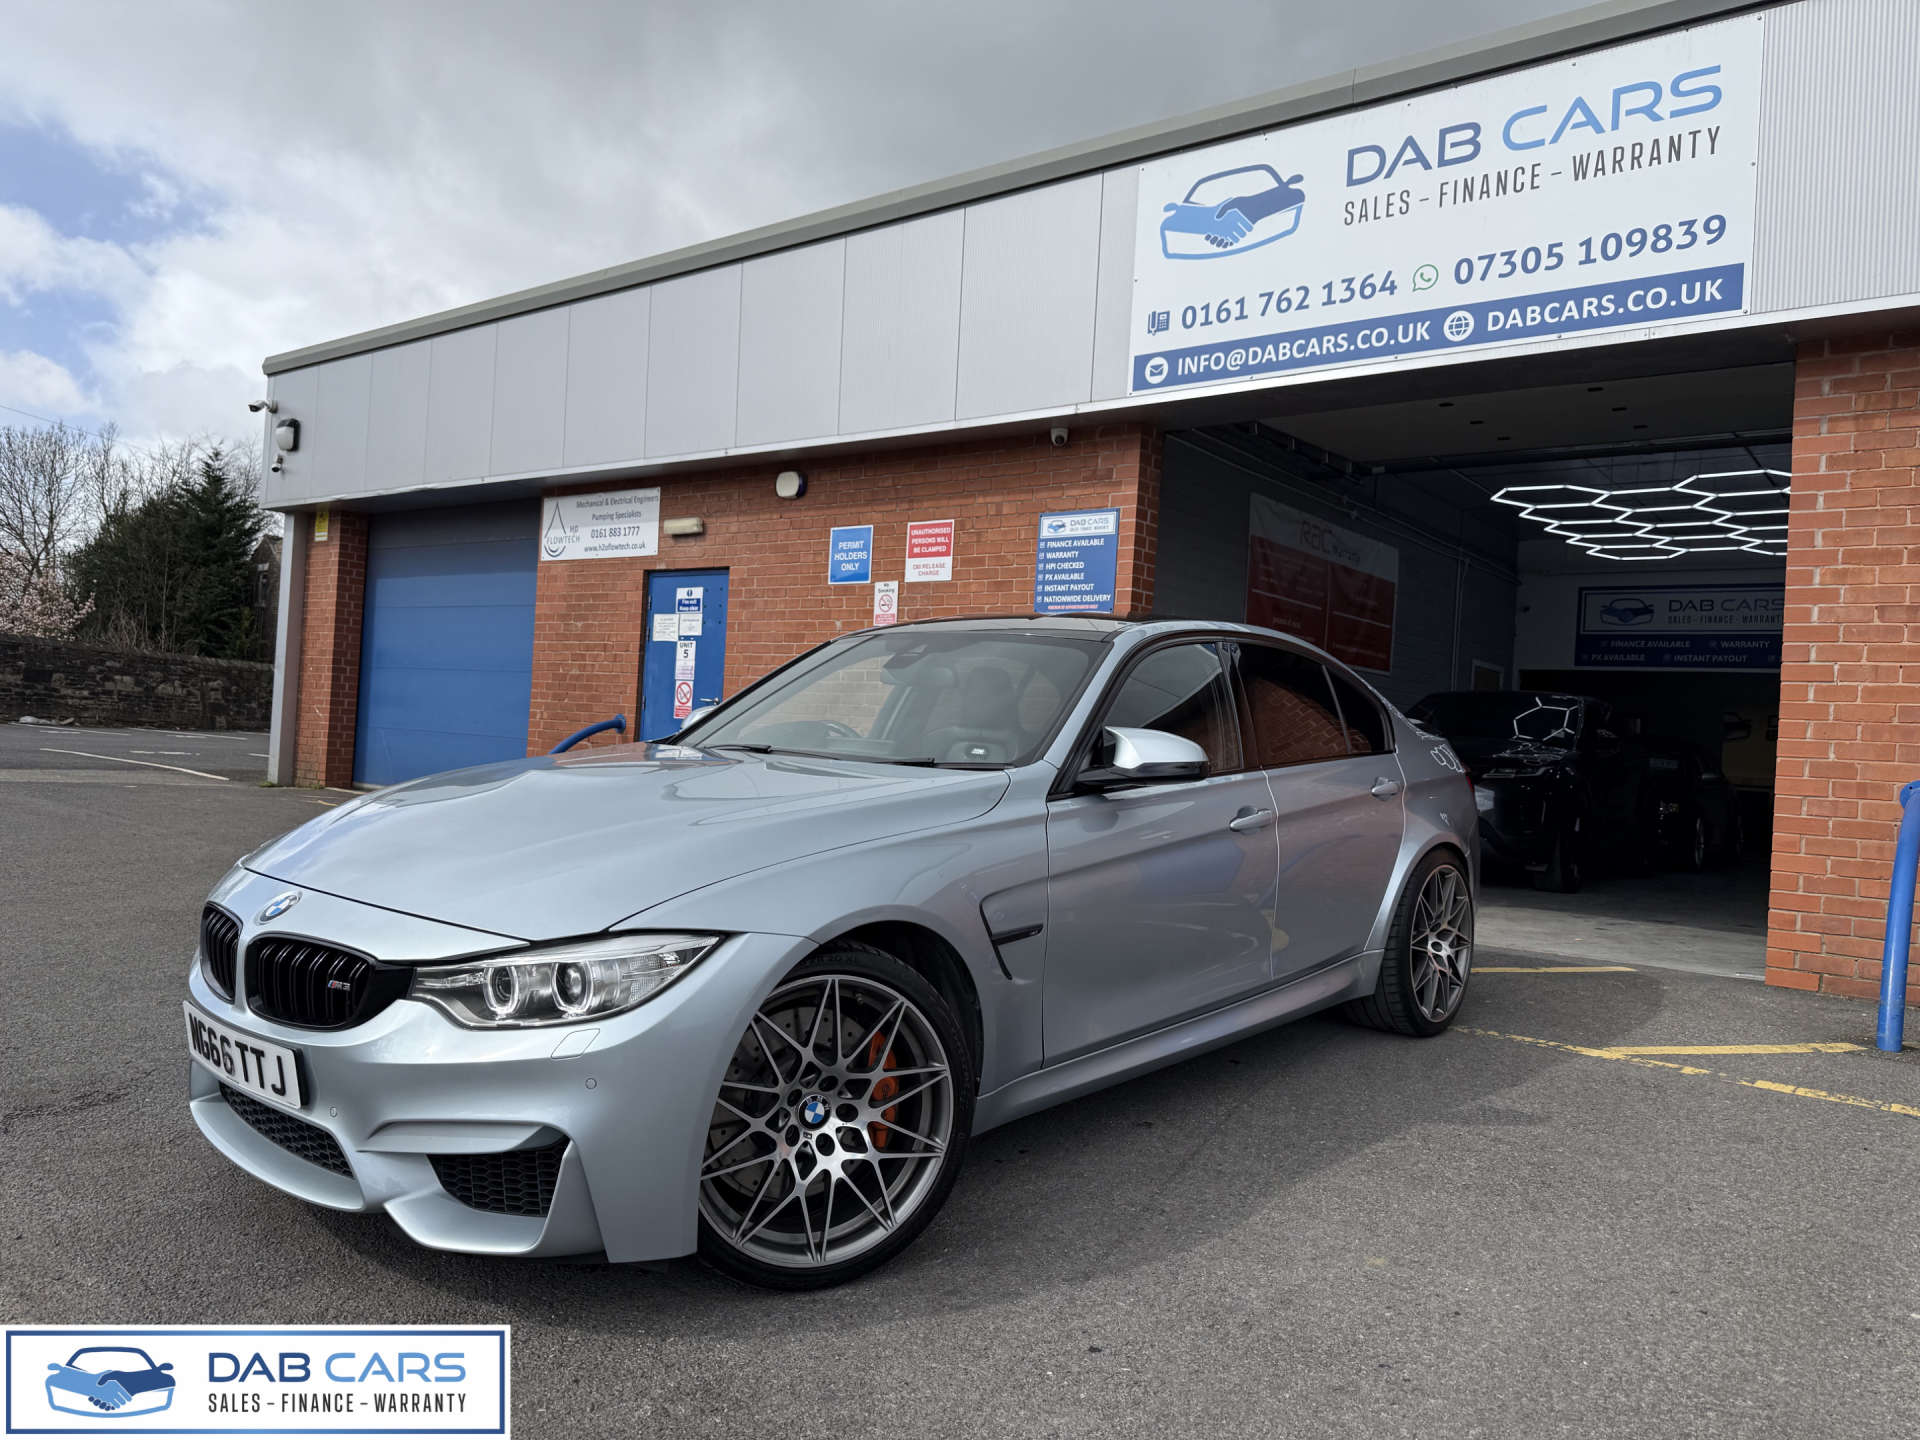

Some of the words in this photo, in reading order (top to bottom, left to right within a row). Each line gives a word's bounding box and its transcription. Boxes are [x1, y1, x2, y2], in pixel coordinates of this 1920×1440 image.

[1346, 122, 1480, 187] DAB
[1502, 65, 1723, 151] CARS
[1343, 189, 1412, 226] SALES
[1438, 163, 1542, 209] FINANCE
[1572, 126, 1723, 182] WARRANTY
[1454, 242, 1565, 286] 07305
[1578, 214, 1728, 266] 109839
[1181, 296, 1249, 331] 0161
[1258, 285, 1311, 319] 762
[1320, 269, 1398, 308] 1364
[1487, 278, 1724, 333] DABCARS.CO.UK
[1177, 321, 1431, 377] INFO@DABCARS.CO.UK
[592, 513, 614, 522] Pumping
[591, 528, 607, 538] 0161
[608, 527, 621, 537] 883
[623, 526, 640, 536] 1777
[547, 536, 580, 544] FLOWTECH
[839, 540, 864, 550] PERMIT
[1047, 540, 1072, 549] FINANCE
[1073, 538, 1104, 546] AVAILABLE
[921, 545, 947, 553] CLAMPED
[834, 552, 868, 561] HOLDERS
[1046, 551, 1079, 559] WARRANTY
[841, 562, 860, 571] ONLY
[1045, 562, 1056, 570] HPI
[1057, 561, 1085, 569] CHECKED
[1045, 573, 1053, 581] PX
[1053, 572, 1085, 580] AVAILABLE
[1044, 584, 1069, 592] INSTANT
[1070, 583, 1095, 591] PAYOUT
[1043, 594, 1081, 603] NATIONWIDE
[1082, 593, 1111, 602] DELIVERY
[1668, 599, 1714, 612] DAB
[1720, 598, 1784, 612] CARS
[1742, 615, 1784, 624] WARRANT
[683, 649, 689, 658] 5
[234, 1038, 287, 1097] TTJ
